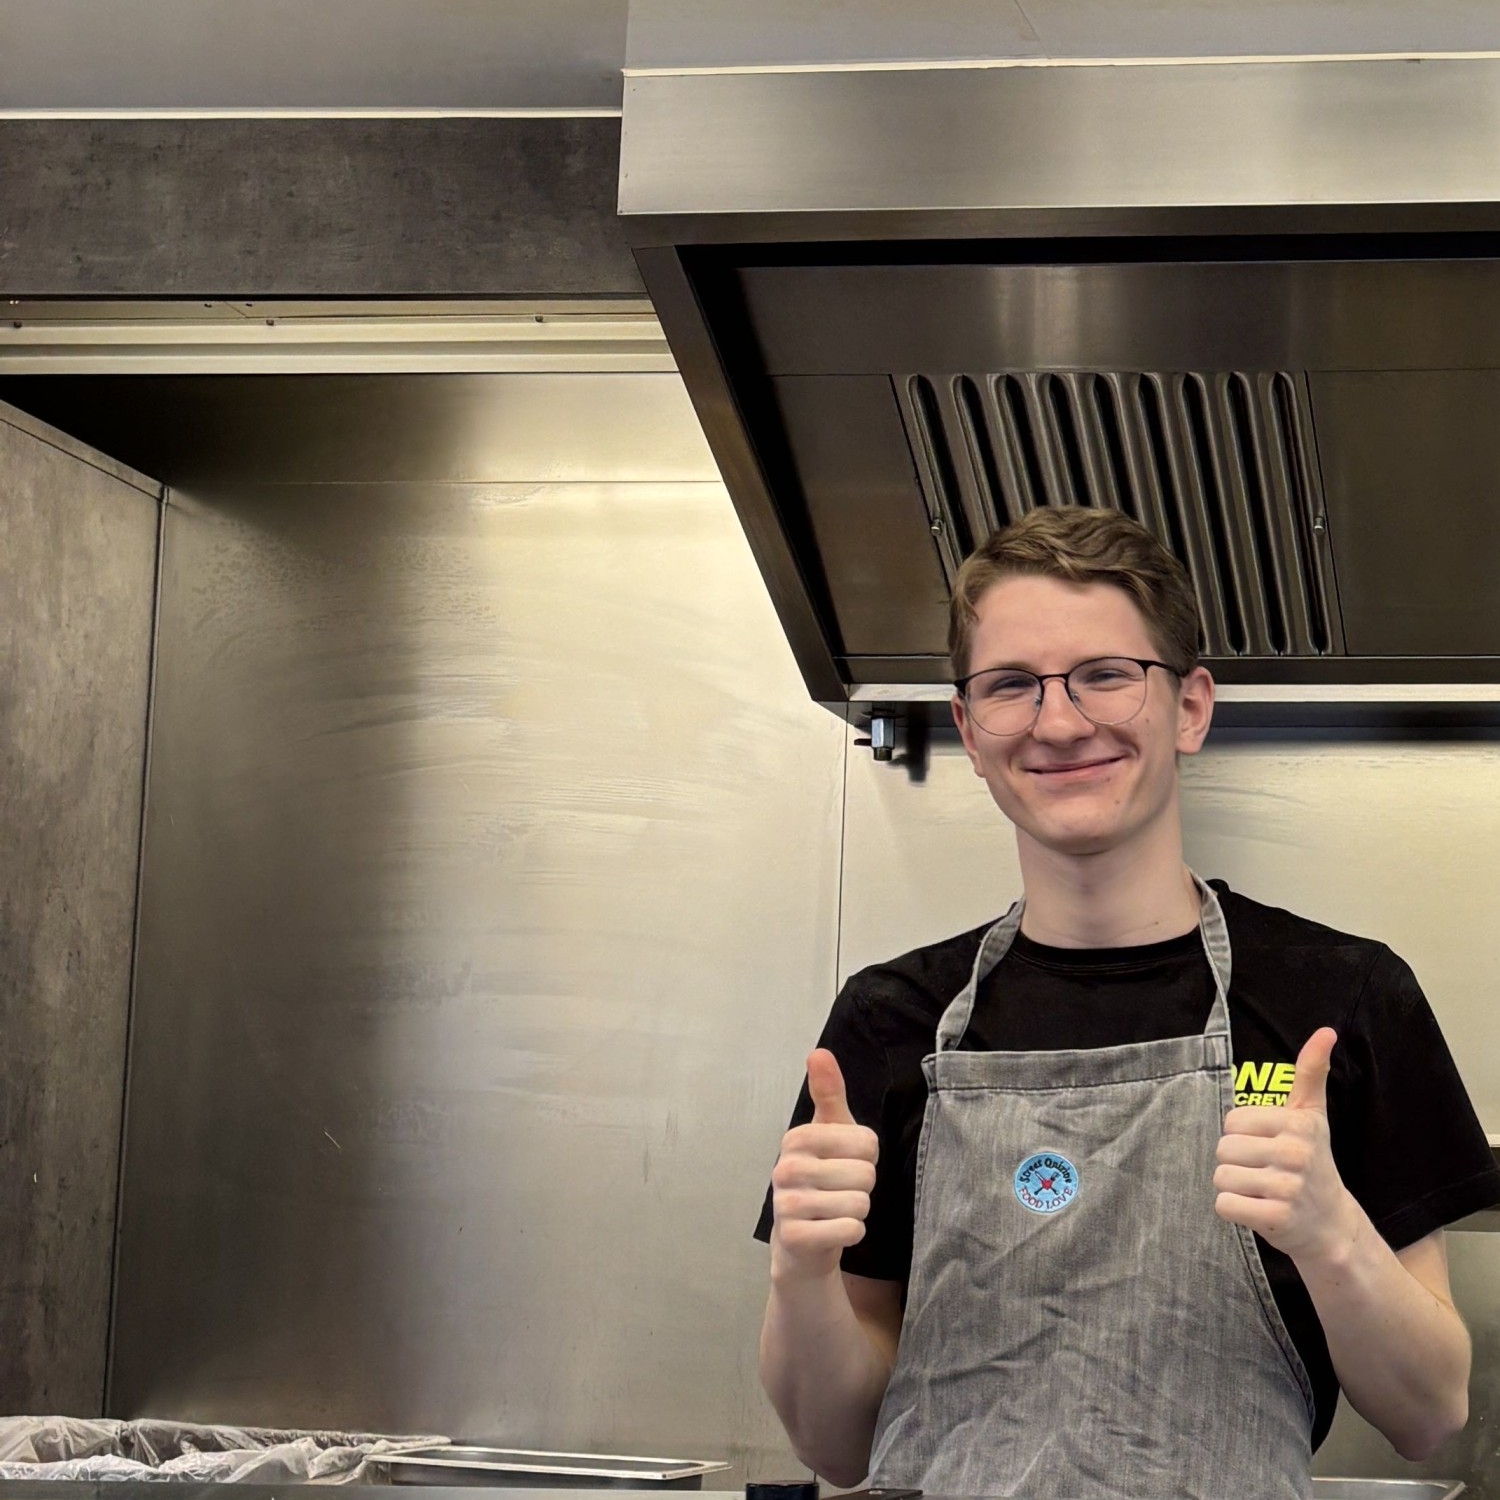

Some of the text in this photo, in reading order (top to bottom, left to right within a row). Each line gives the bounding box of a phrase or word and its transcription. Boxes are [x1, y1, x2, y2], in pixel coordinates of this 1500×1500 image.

[1230, 1061, 1296, 1092] NE
[1233, 1092, 1290, 1107] CREW
[1045, 1186, 1074, 1210] LOVE
